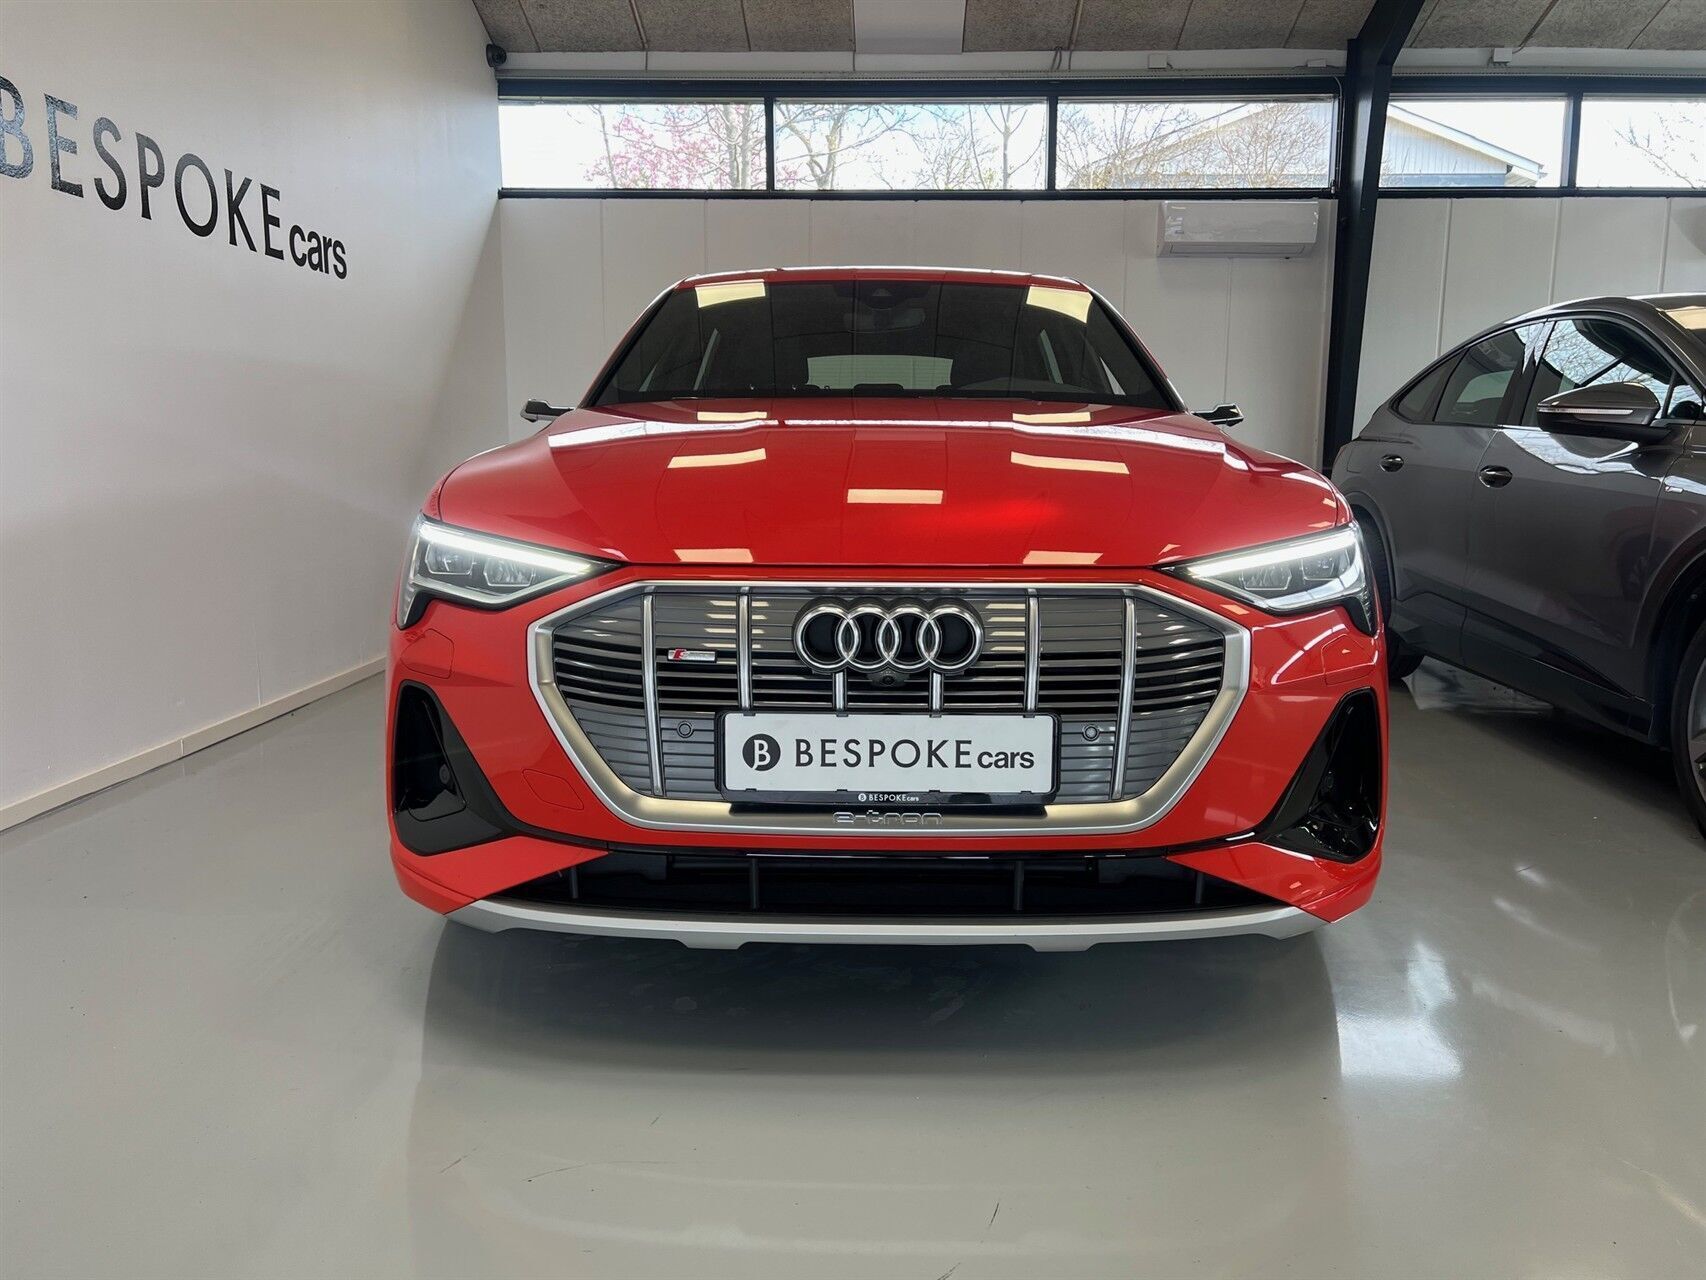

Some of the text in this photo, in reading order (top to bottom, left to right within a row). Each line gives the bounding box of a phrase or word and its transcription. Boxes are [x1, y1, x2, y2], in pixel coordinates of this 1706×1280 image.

[0, 74, 348, 280] BESPOKE cars
[795, 738, 972, 769] BESPOKE
[976, 750, 1035, 769] cars
[868, 793, 907, 802] BESPOKE
[832, 809, 944, 825] e-tron
